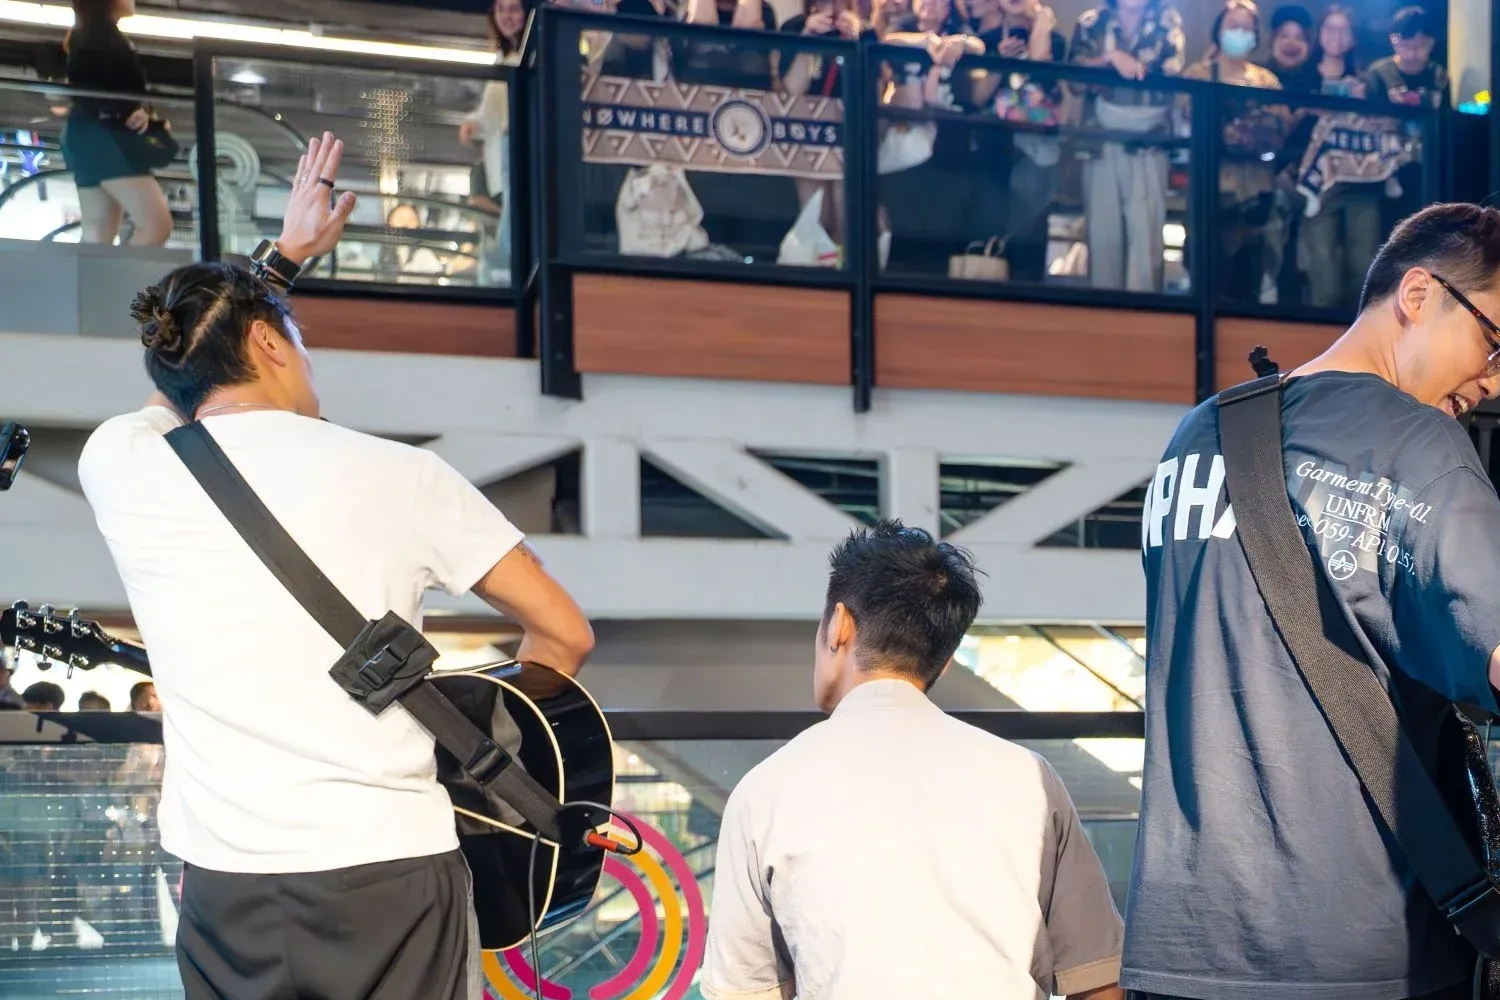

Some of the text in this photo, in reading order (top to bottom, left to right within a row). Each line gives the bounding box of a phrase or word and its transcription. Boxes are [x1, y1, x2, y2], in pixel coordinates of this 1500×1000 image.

[1296, 460, 1374, 496] Garment
[1143, 453, 1237, 553] PH
[1326, 494, 1392, 533] UNFRM
